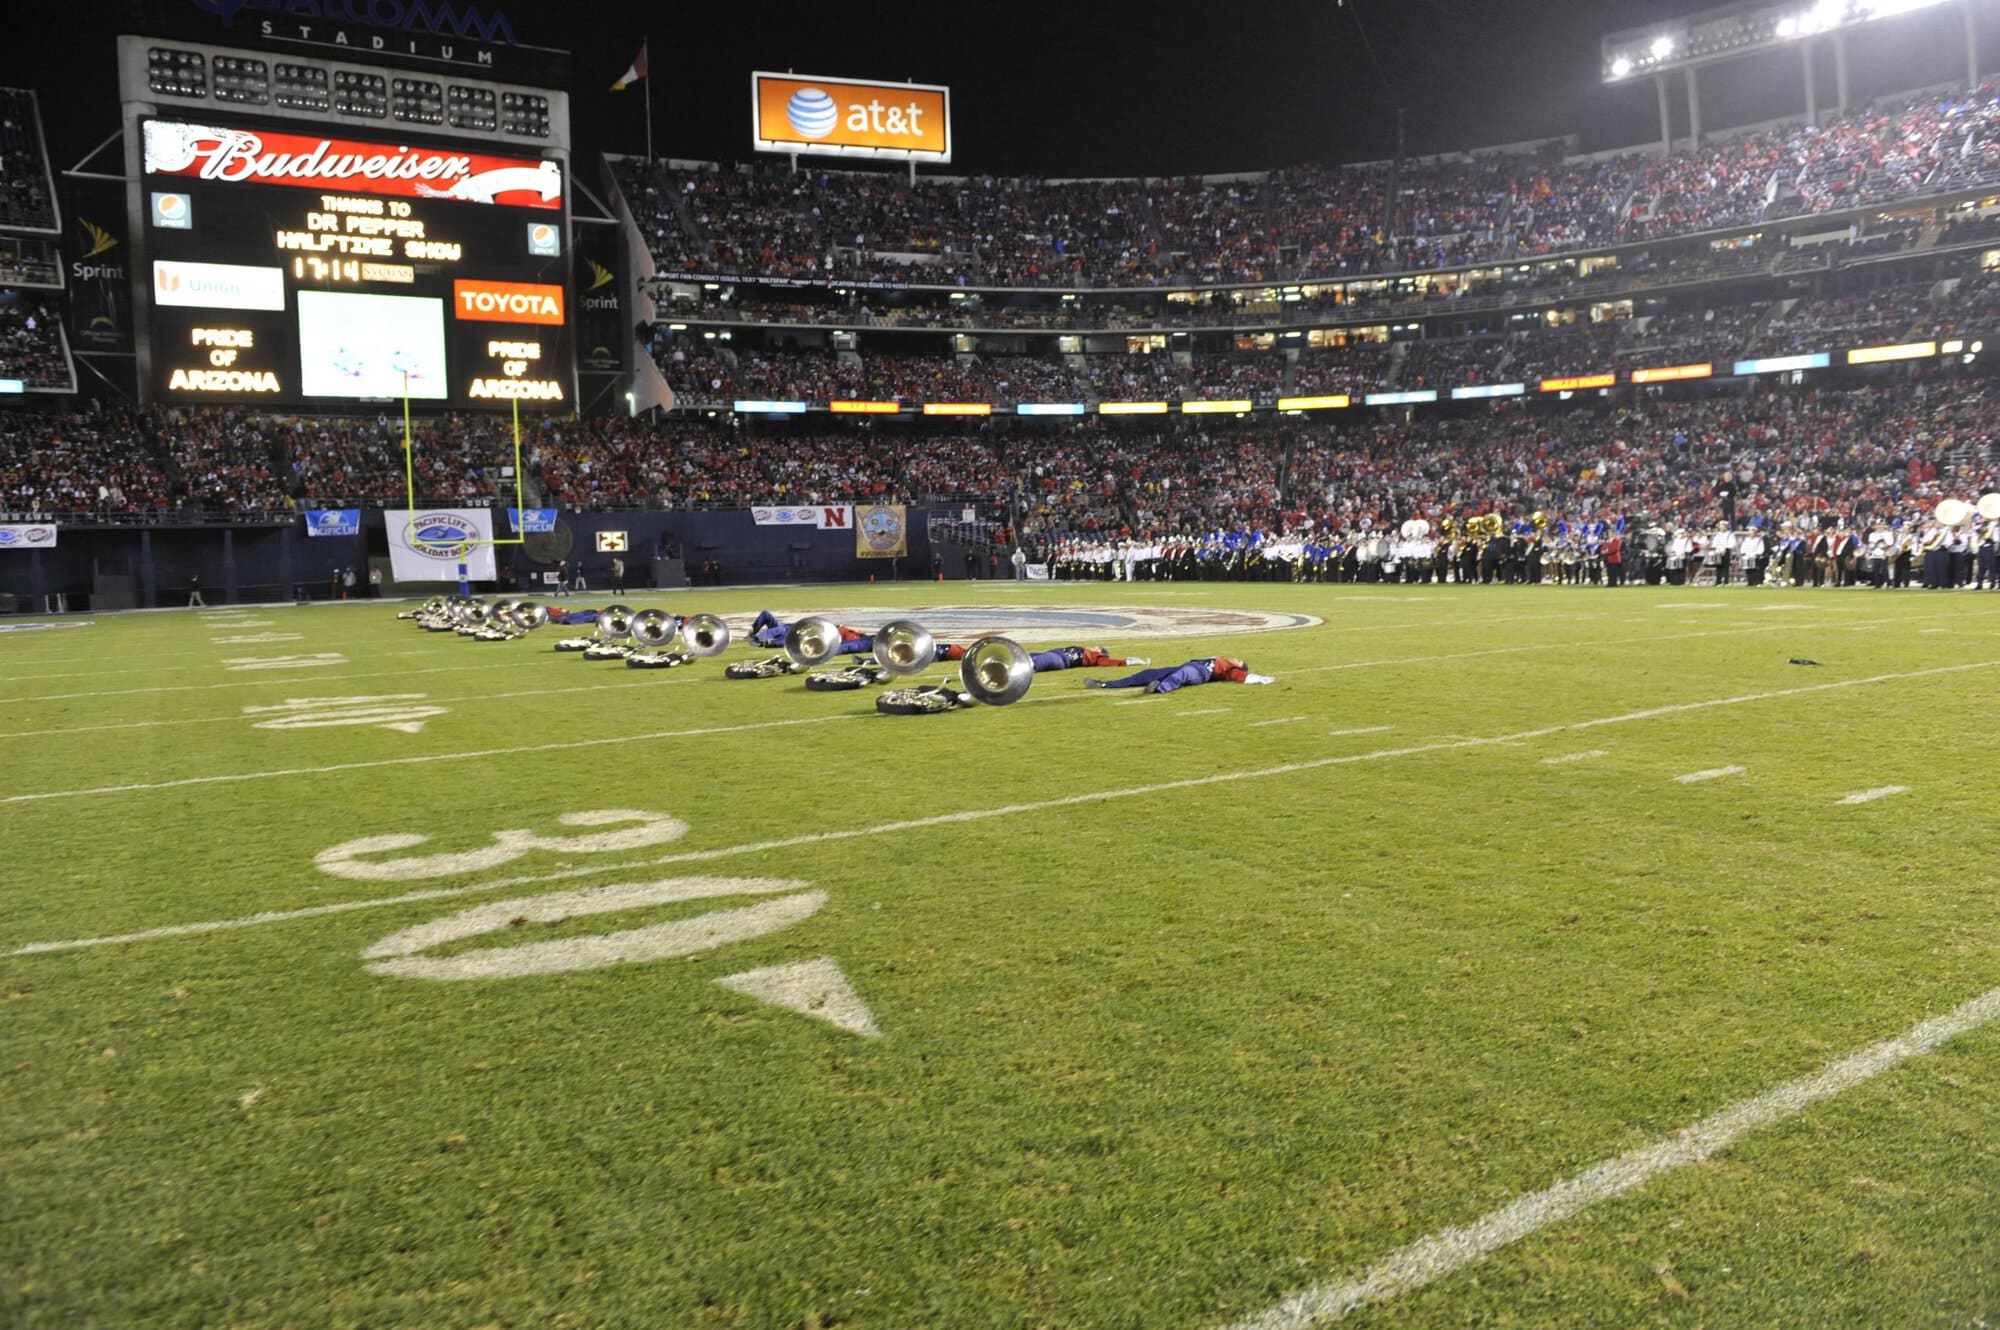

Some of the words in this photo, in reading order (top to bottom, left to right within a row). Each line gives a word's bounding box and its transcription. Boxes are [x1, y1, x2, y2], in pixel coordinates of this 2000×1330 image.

[261, 20, 492, 65] STADIUM
[846, 99, 923, 136] at&t
[192, 130, 470, 182] Budweiser
[388, 201, 412, 217] TO
[306, 212, 338, 231] DR
[345, 215, 425, 238] PEPPER
[276, 230, 393, 256] HALFTIME
[404, 240, 461, 261] SHOW
[72, 262, 124, 281] Sprint
[295, 256, 360, 282] 17:14
[460, 290, 559, 316] TOYOTA
[191, 328, 253, 347] PRIDE
[209, 349, 237, 367] OF
[488, 341, 540, 359] PRIDE
[503, 360, 527, 376] OF
[168, 369, 280, 392] ARIZONA
[469, 378, 563, 400] ARIZONA
[413, 516, 446, 530] PACIFIC
[447, 516, 467, 530] LIFE
[824, 507, 845, 527] N
[599, 531, 625, 551] 25
[314, 808, 829, 981] 30
